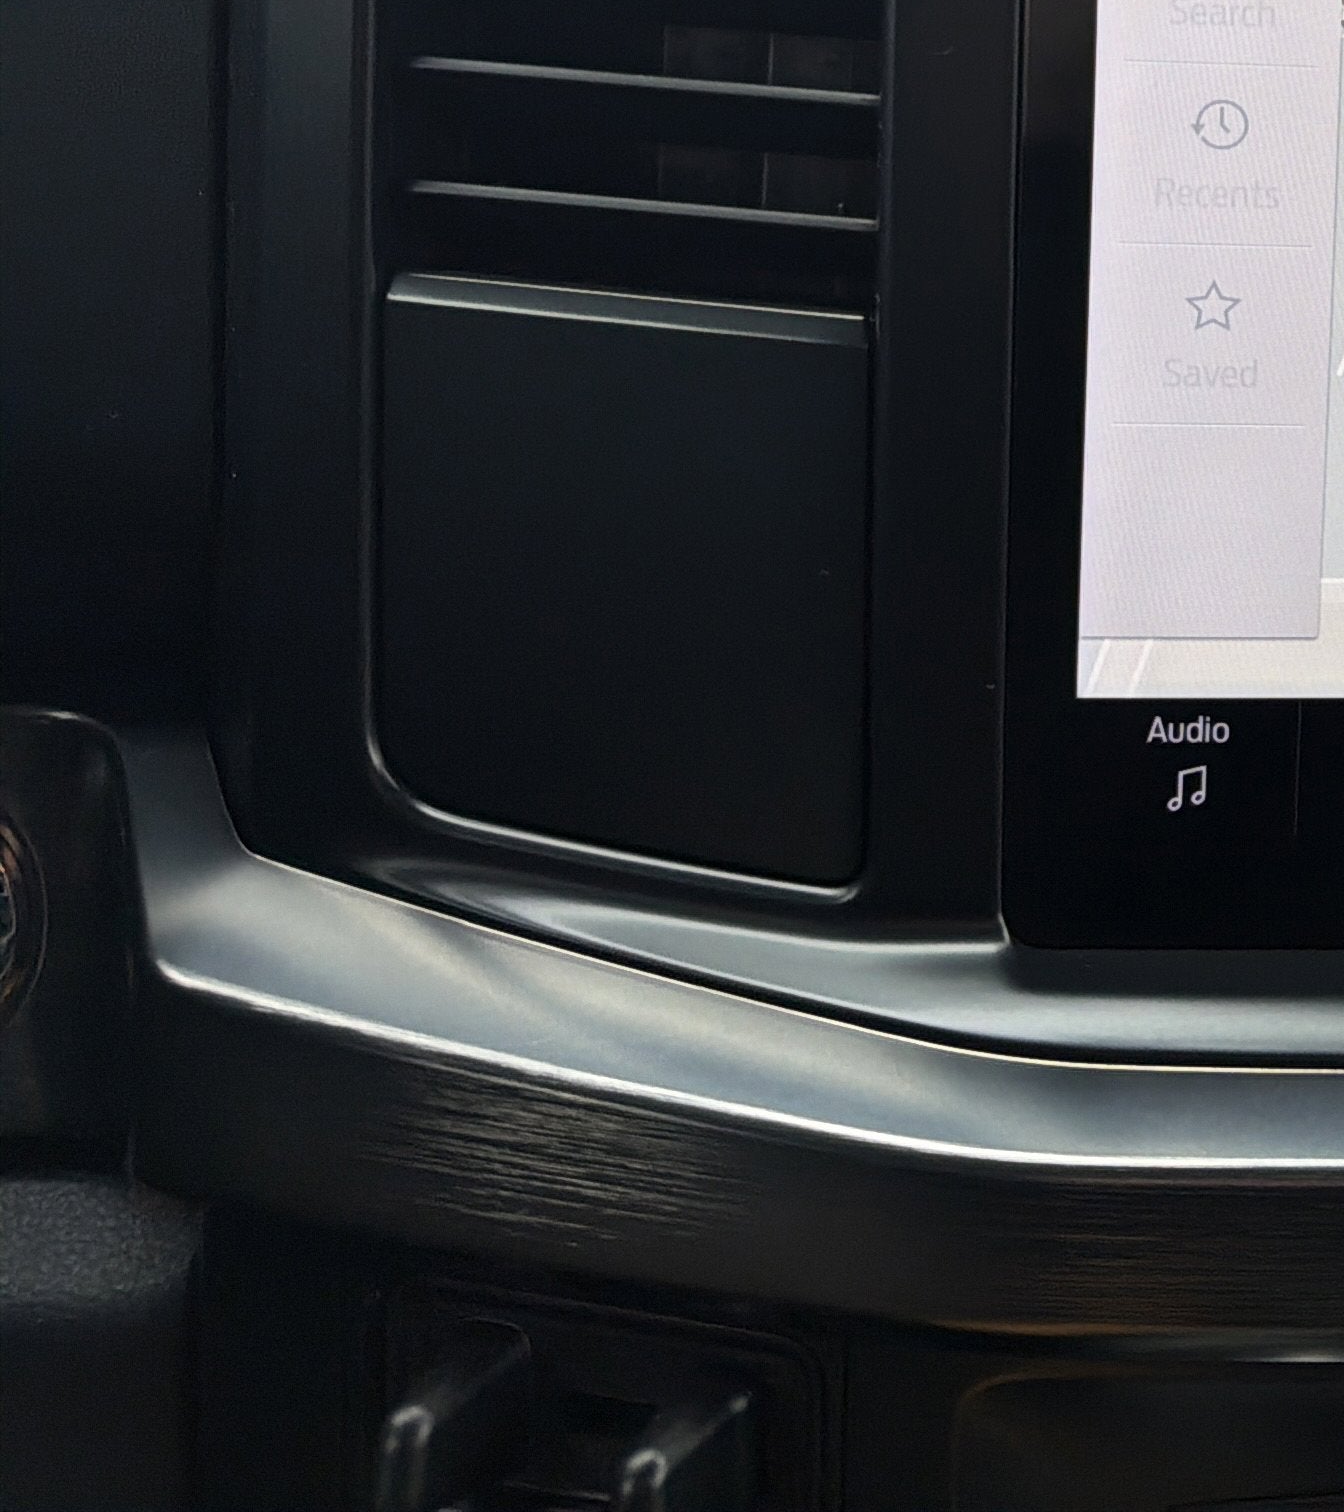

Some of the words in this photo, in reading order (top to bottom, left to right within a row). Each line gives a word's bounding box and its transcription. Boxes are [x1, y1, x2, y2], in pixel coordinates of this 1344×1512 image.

[1154, 178, 1280, 211] Recents
[1163, 358, 1258, 390] Saved
[1147, 716, 1230, 744] Audio
